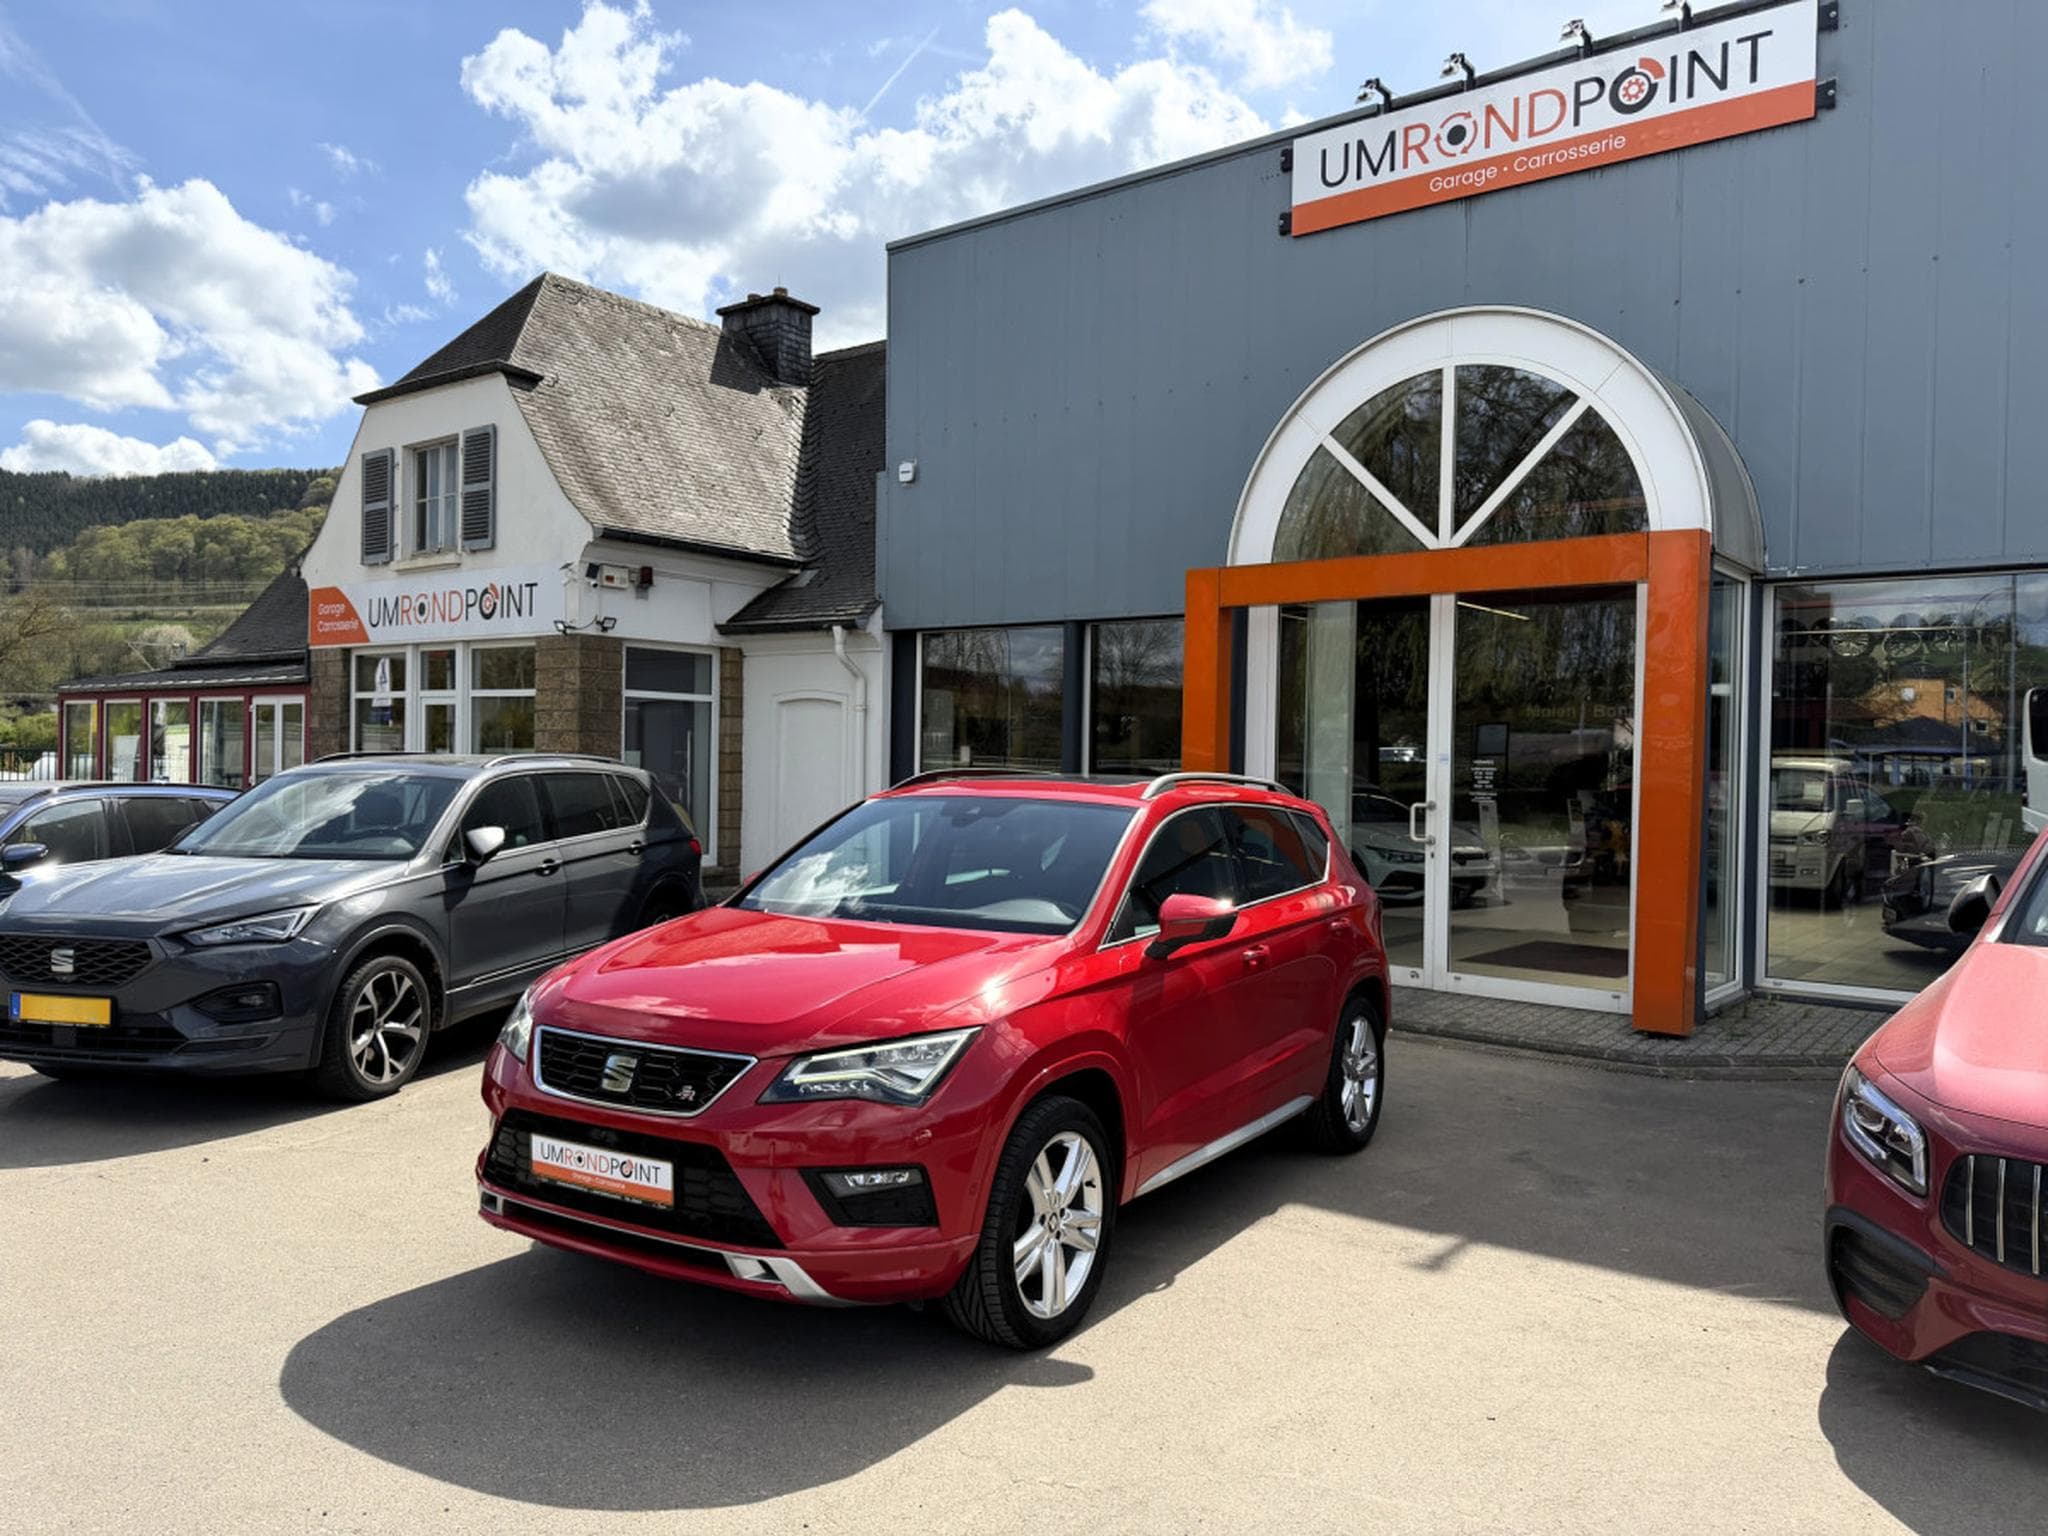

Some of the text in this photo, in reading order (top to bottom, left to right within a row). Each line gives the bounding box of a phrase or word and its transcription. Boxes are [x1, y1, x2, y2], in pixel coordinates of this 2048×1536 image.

[1319, 29, 1774, 188] UMRONDPOINT
[1430, 133, 1627, 192] Garage Carrosserie
[317, 603, 346, 617] Garage
[367, 581, 538, 628] UMRONDPOINT
[539, 1140, 661, 1185] UMRONDPOINT
